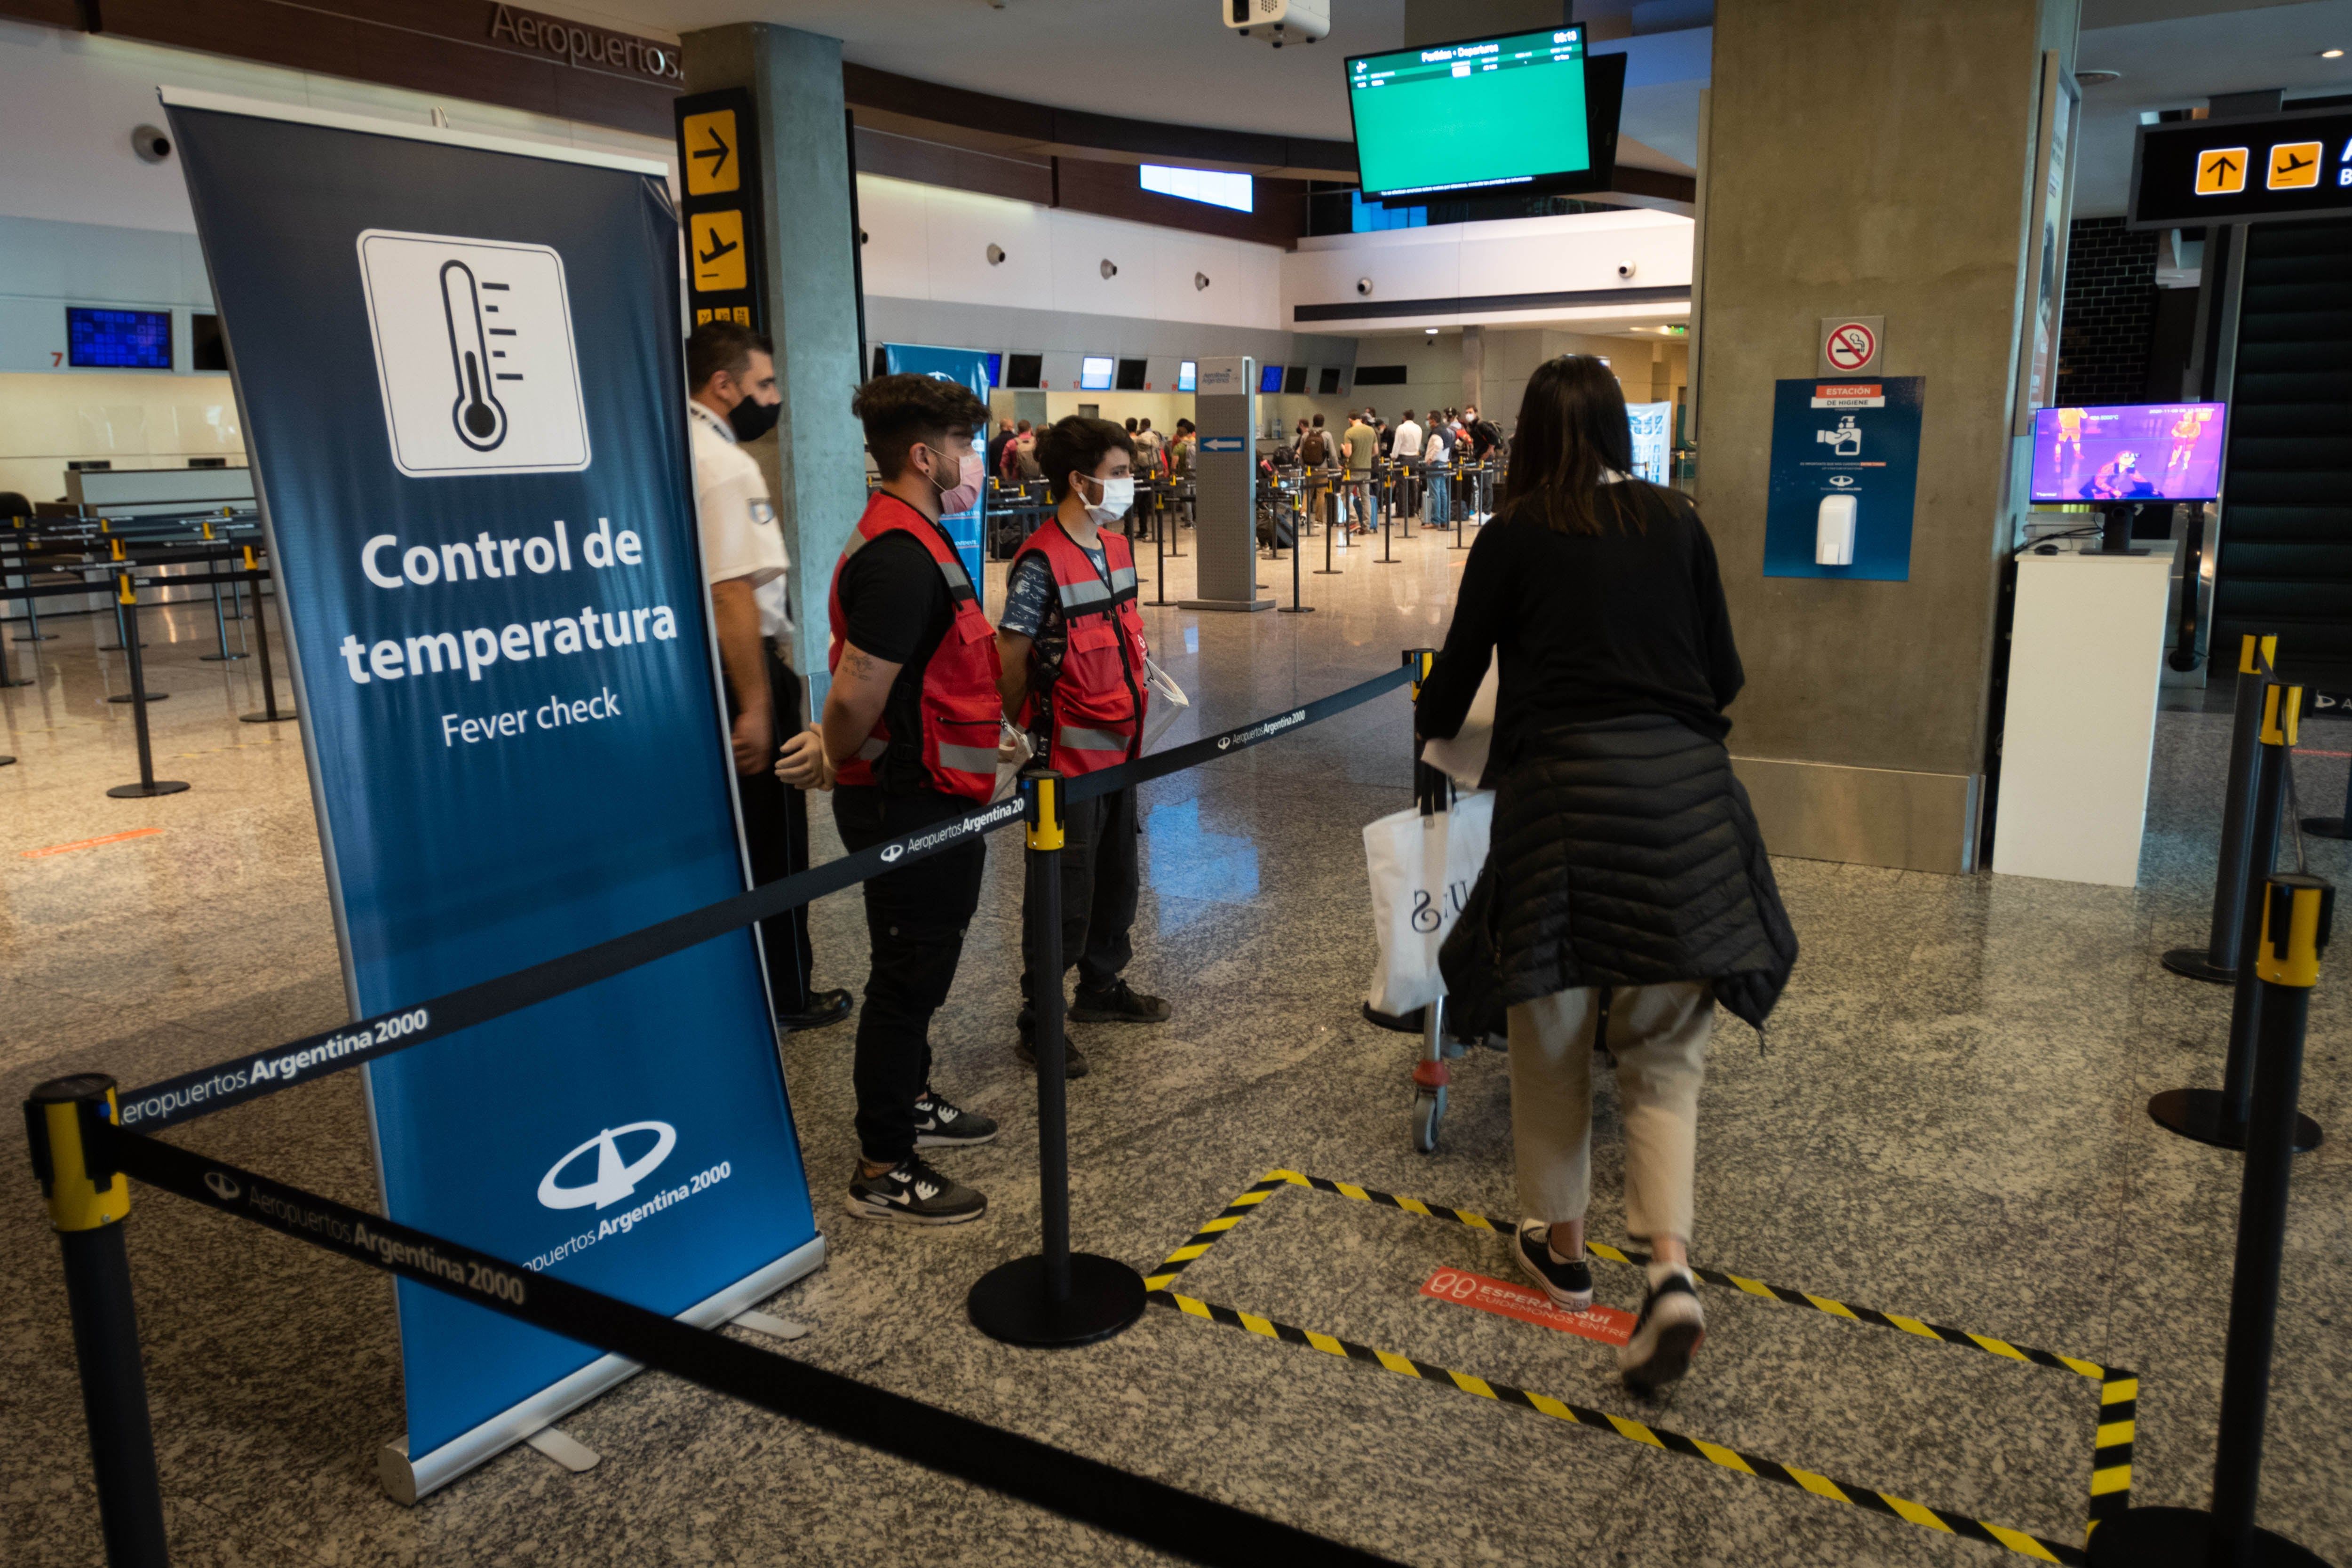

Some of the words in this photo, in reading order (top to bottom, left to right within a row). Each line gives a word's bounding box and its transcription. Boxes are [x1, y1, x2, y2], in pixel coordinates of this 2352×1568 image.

[492, 3, 679, 79] Aeropuertos
[51, 352, 63, 366] 7
[1826, 386, 1871, 395] ESTACIÓN
[362, 520, 572, 589] Control
[583, 517, 642, 568] de
[339, 604, 678, 684] temperatura
[441, 708, 528, 747] Fever
[536, 687, 621, 729] check
[1232, 726, 1264, 746] Aeropuertos
[1263, 716, 1293, 734] Argentina
[1292, 709, 1305, 724] 2000
[907, 823, 962, 854] Aeropuertos
[962, 804, 1011, 832] Argentina
[120, 1069, 247, 1125] eropuertos
[249, 1030, 373, 1084] Argentina
[374, 1009, 429, 1044] 2000
[597, 1184, 690, 1240] Argentina
[690, 1161, 731, 1195] 2000
[248, 1185, 352, 1243] Aeropuertos
[353, 1223, 465, 1284] Argentina
[468, 1262, 525, 1306] 2000
[1578, 1320, 1630, 1339] ENTRE
